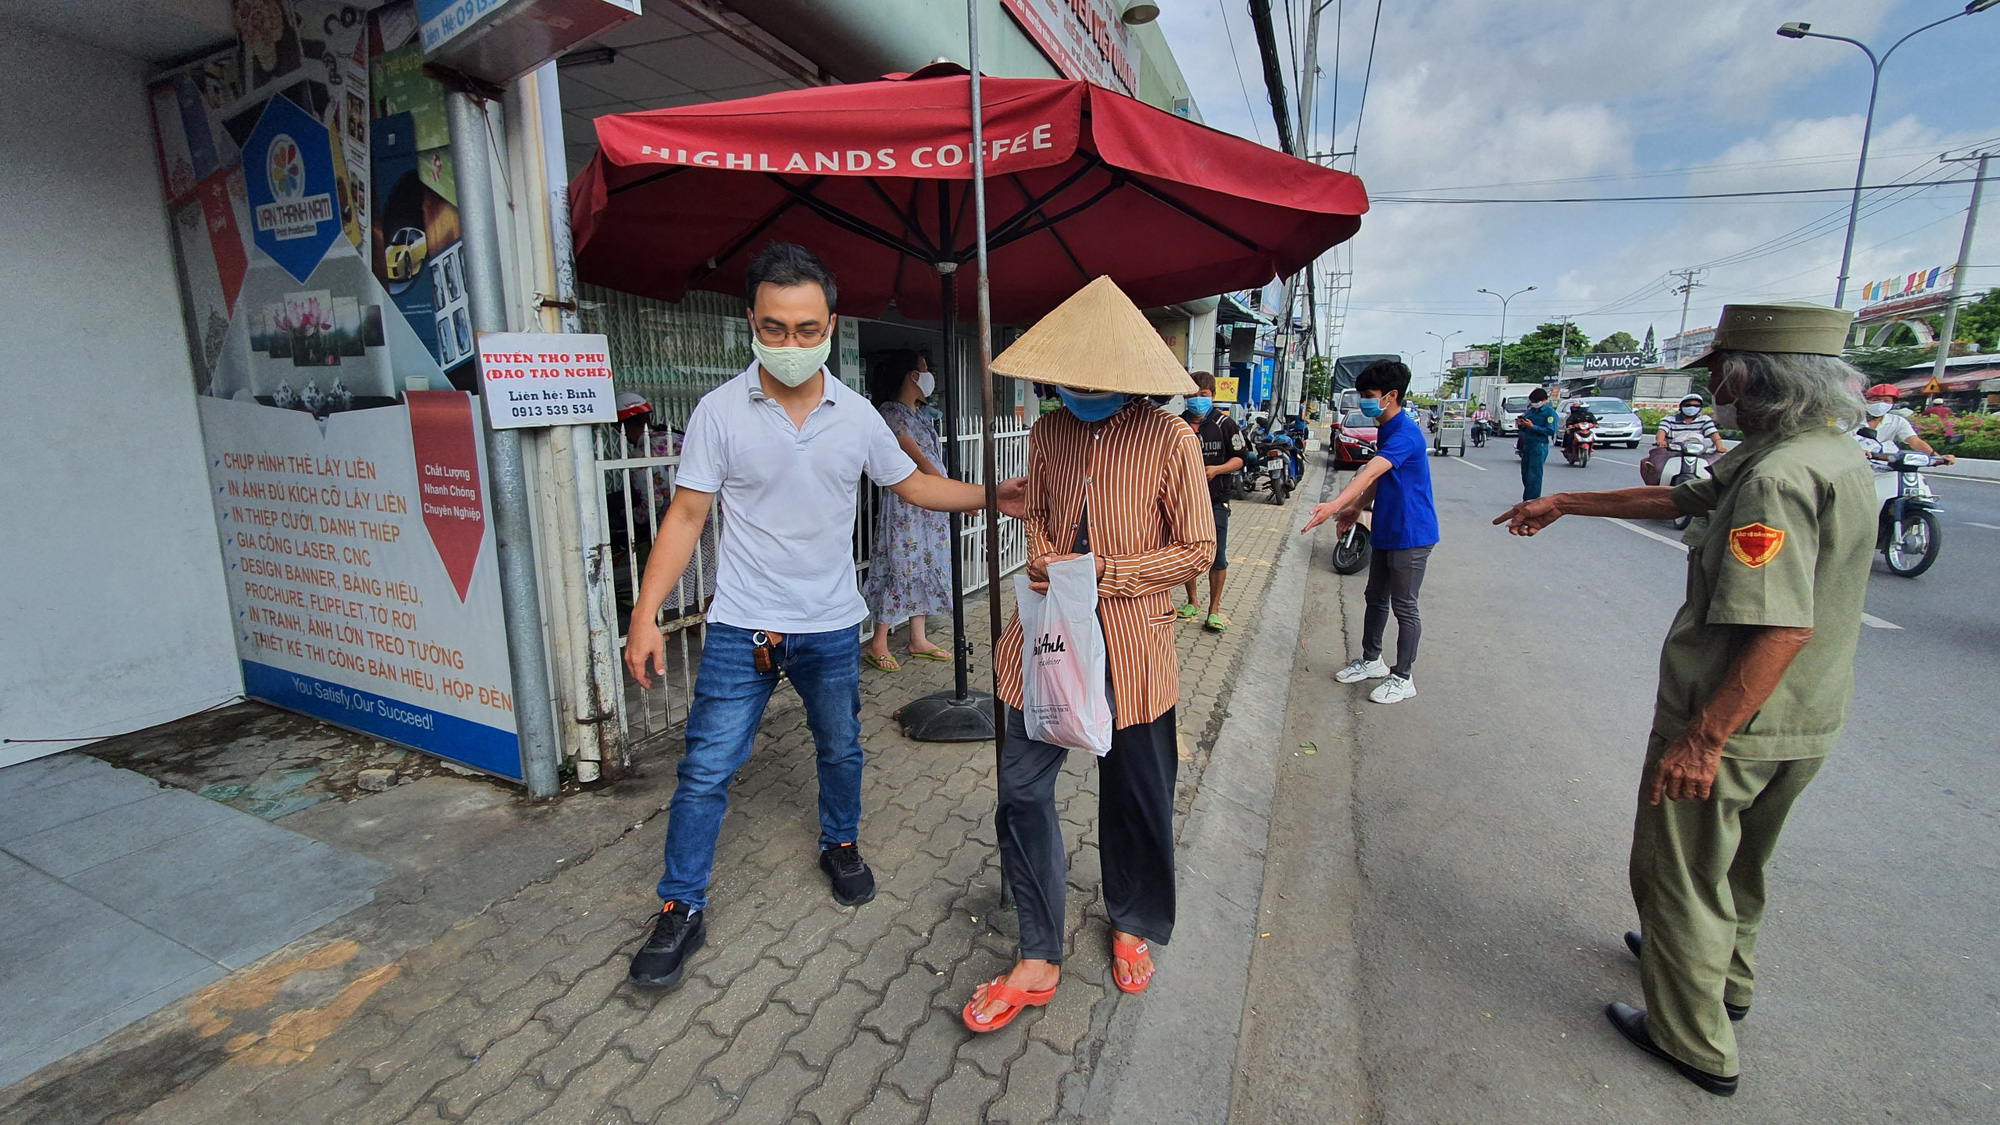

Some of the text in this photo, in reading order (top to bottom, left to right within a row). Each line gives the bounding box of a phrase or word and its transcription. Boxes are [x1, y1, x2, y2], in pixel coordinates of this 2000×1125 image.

[642, 123, 1053, 171] HIGHLANDS COFFEE
[483, 350, 605, 366] TUYỂN THỢ PHỤ
[529, 368, 560, 380] TẠO
[1586, 355, 1609, 368] HÒA
[1611, 354, 1640, 368] TUỘC
[508, 390, 540, 401] Liên
[566, 388, 597, 399] Bình
[511, 403, 594, 417] 0913 539 534
[224, 452, 254, 474] CHỤP
[257, 450, 285, 473] HÌNH
[316, 454, 341, 477] LẤY
[344, 456, 377, 480] LIỀN
[444, 465, 470, 481] Lượng
[228, 480, 239, 497] IN
[287, 481, 318, 504] KÍCH
[344, 487, 371, 510] LẤY
[374, 489, 408, 514] LIỀN
[424, 483, 476, 501] Nhanh Chóng
[232, 506, 244, 523] IN
[319, 516, 357, 537] DANH
[359, 519, 401, 543] THIẾP
[423, 502, 481, 521] Chuyên Nghiệp
[237, 531, 371, 567] GIA CÔNG LASER, CNC
[240, 556, 282, 579] DESIGN
[285, 564, 341, 592] BANNER,
[244, 582, 308, 611] PROCHURE,
[369, 602, 388, 624] TỜ
[391, 608, 417, 631] RƠI
[248, 605, 260, 623] IN
[262, 608, 306, 636] TRANH,
[336, 620, 364, 647] LỚN
[366, 630, 405, 656] TREO
[407, 639, 464, 670] TƯỜNG
[287, 637, 304, 657] KẾ
[305, 643, 325, 663] THI
[328, 648, 365, 673] CÔNG
[442, 676, 474, 703] HỘP
[478, 684, 513, 712] ĐÈN
[292, 676, 313, 696] You
[377, 699, 434, 731] Succeed!
